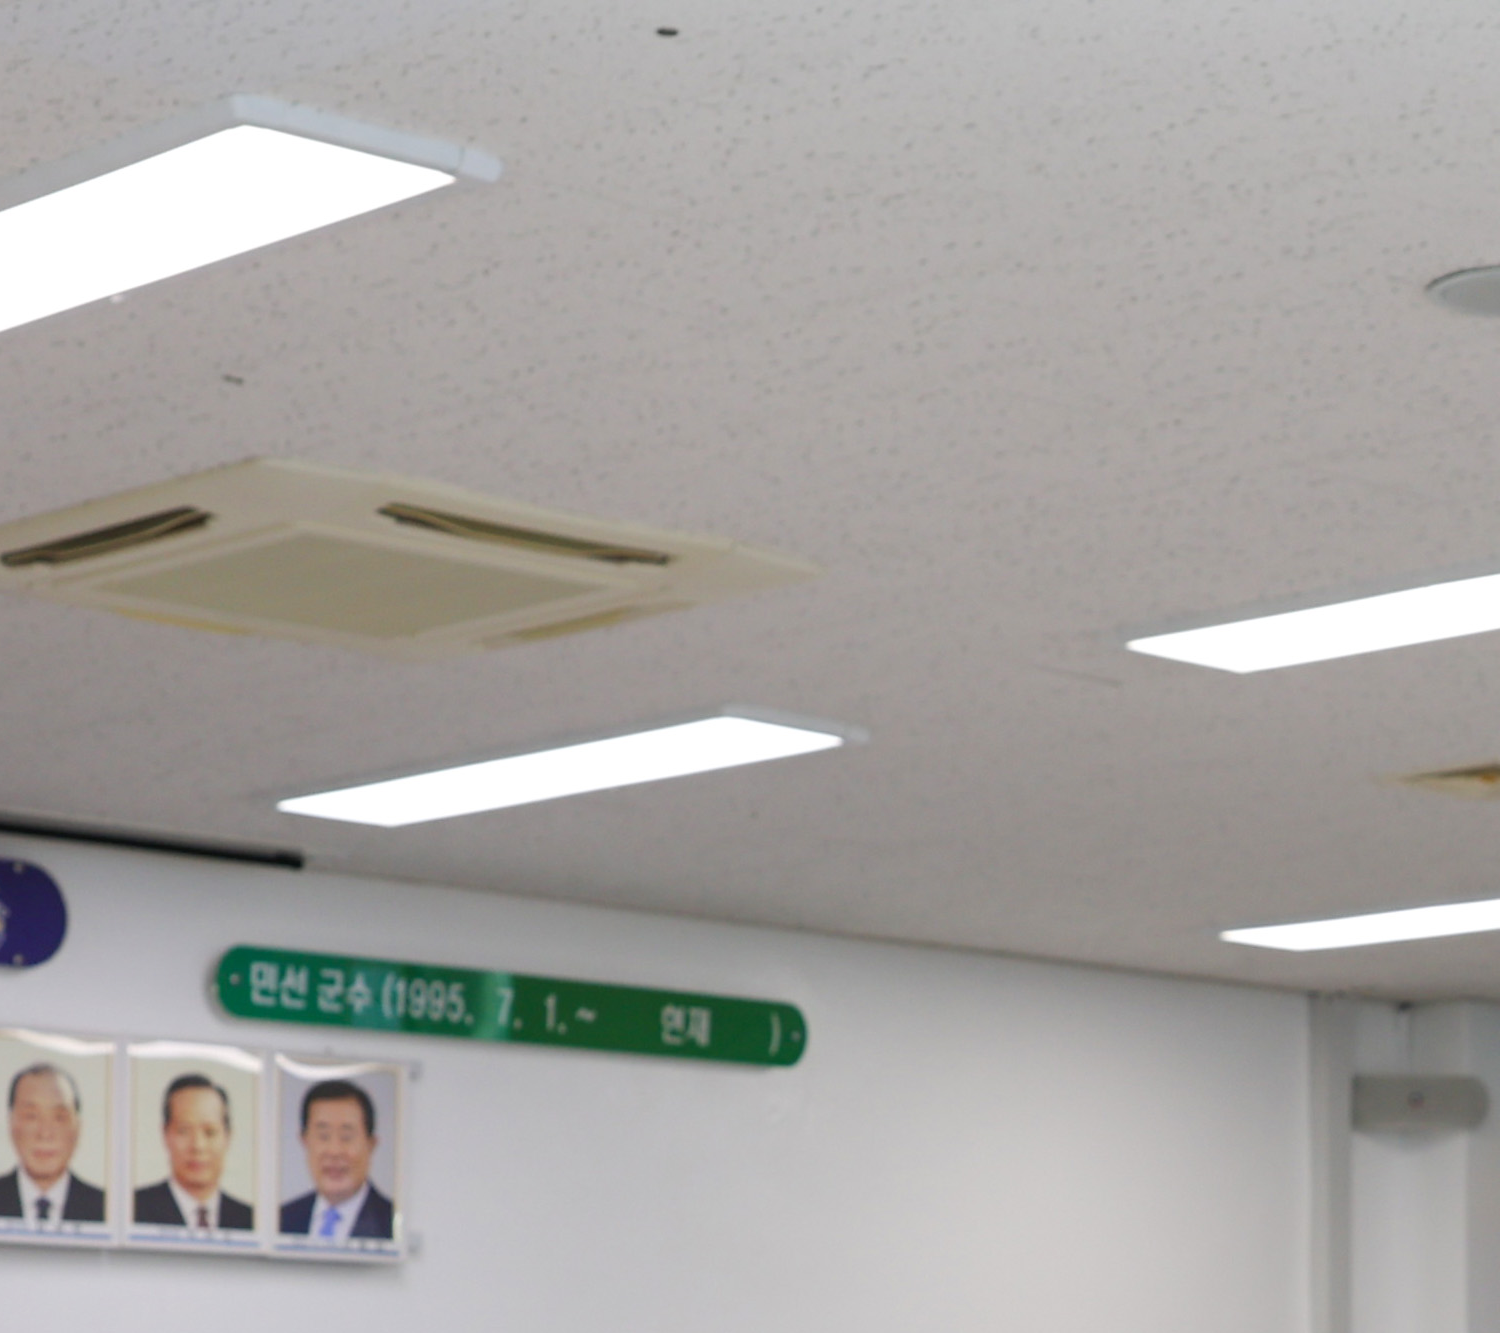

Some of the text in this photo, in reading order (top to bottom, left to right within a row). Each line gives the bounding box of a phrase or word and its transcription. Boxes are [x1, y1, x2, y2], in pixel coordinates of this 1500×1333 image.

[250, 961, 308, 1009] 민선
[317, 968, 372, 1014] 군수
[661, 1003, 711, 1046] 현재
